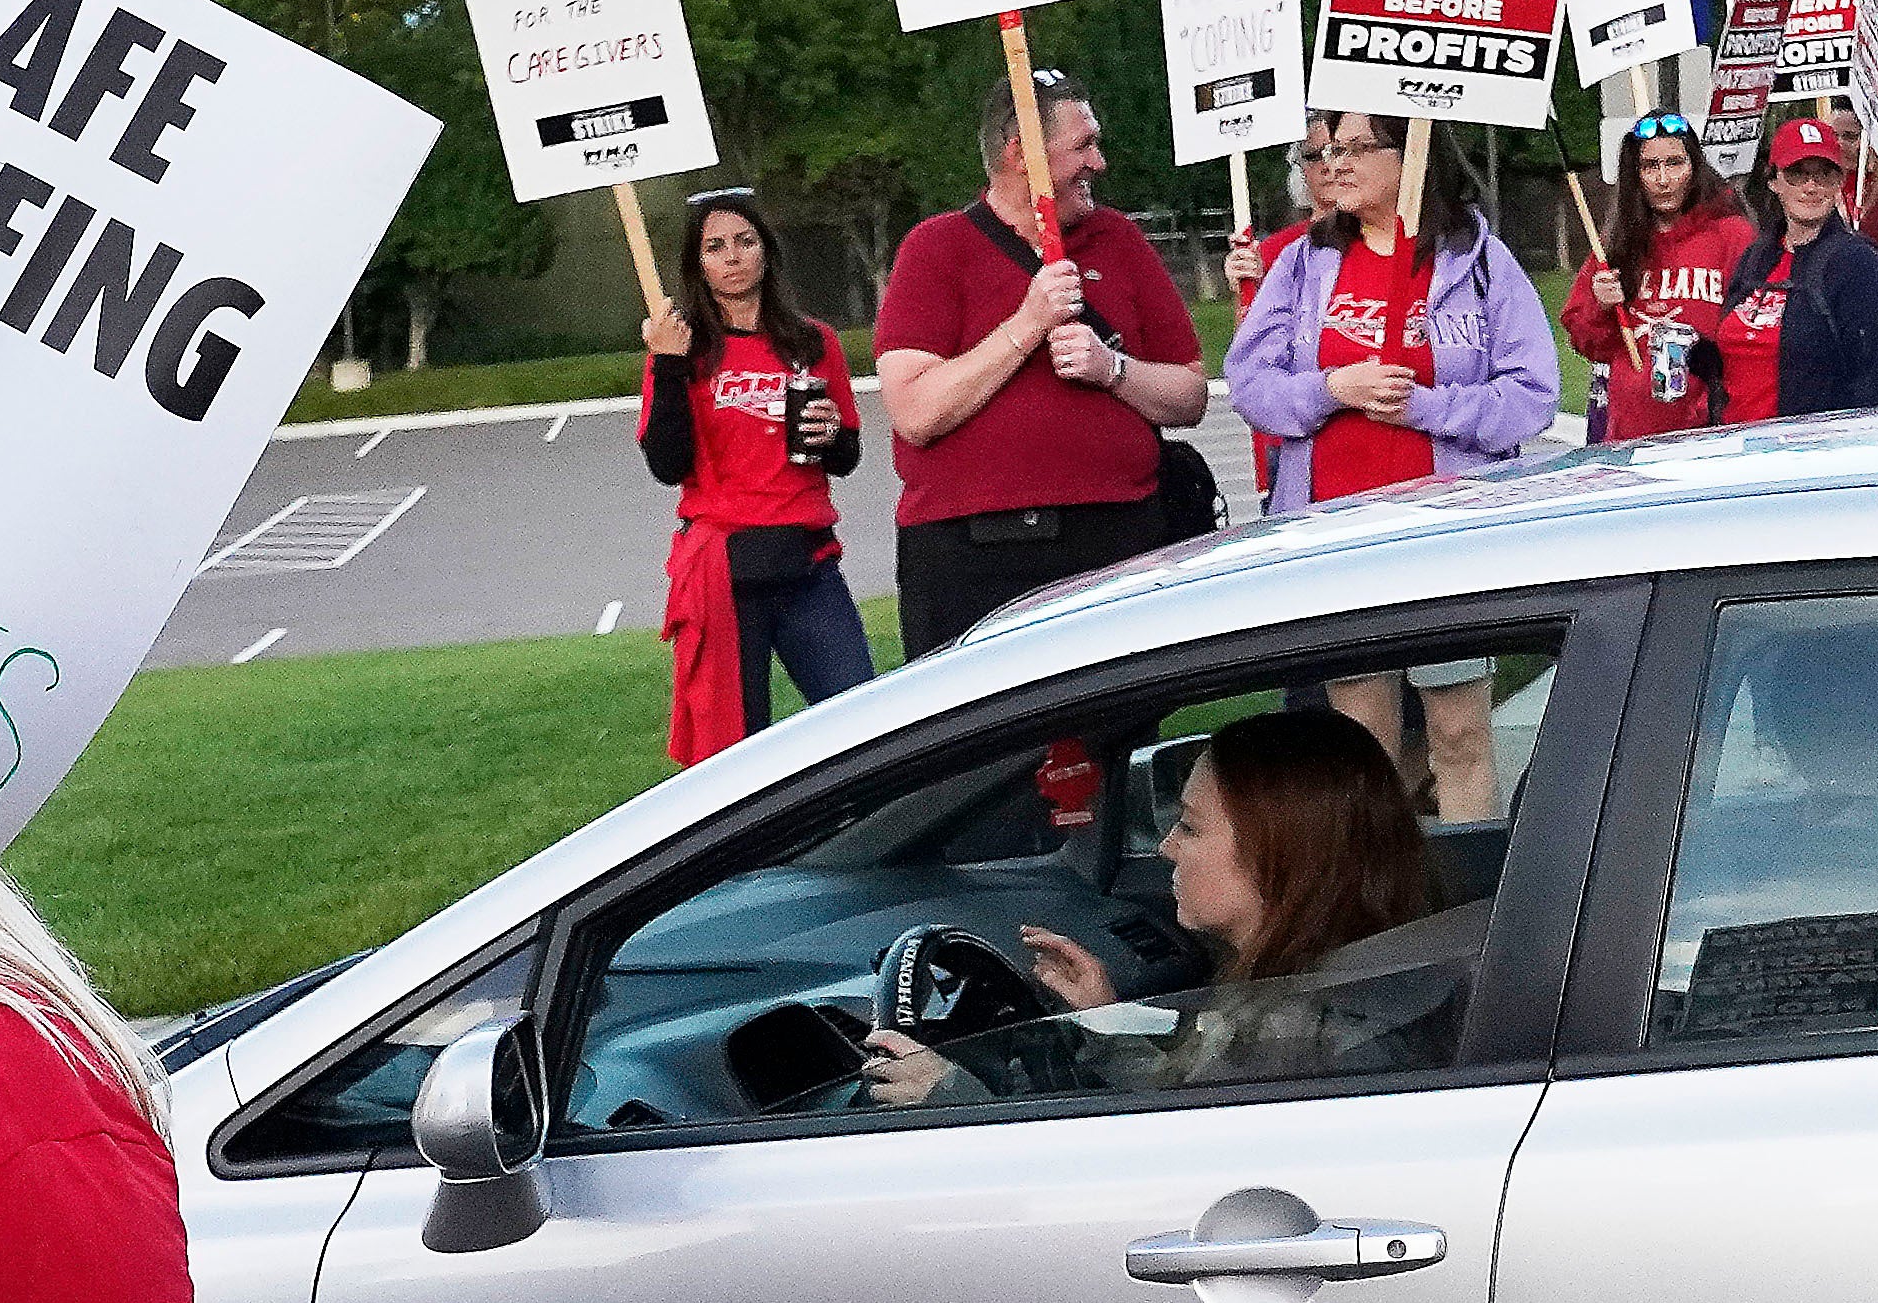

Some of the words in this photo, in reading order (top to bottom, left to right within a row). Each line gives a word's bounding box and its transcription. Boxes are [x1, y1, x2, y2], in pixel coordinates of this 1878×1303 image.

[513, 6, 551, 33] FOR
[507, 32, 664, 84] CAREGIVERS
[1337, 23, 1536, 74] PROFITS
[1658, 267, 1725, 305] LAKE
